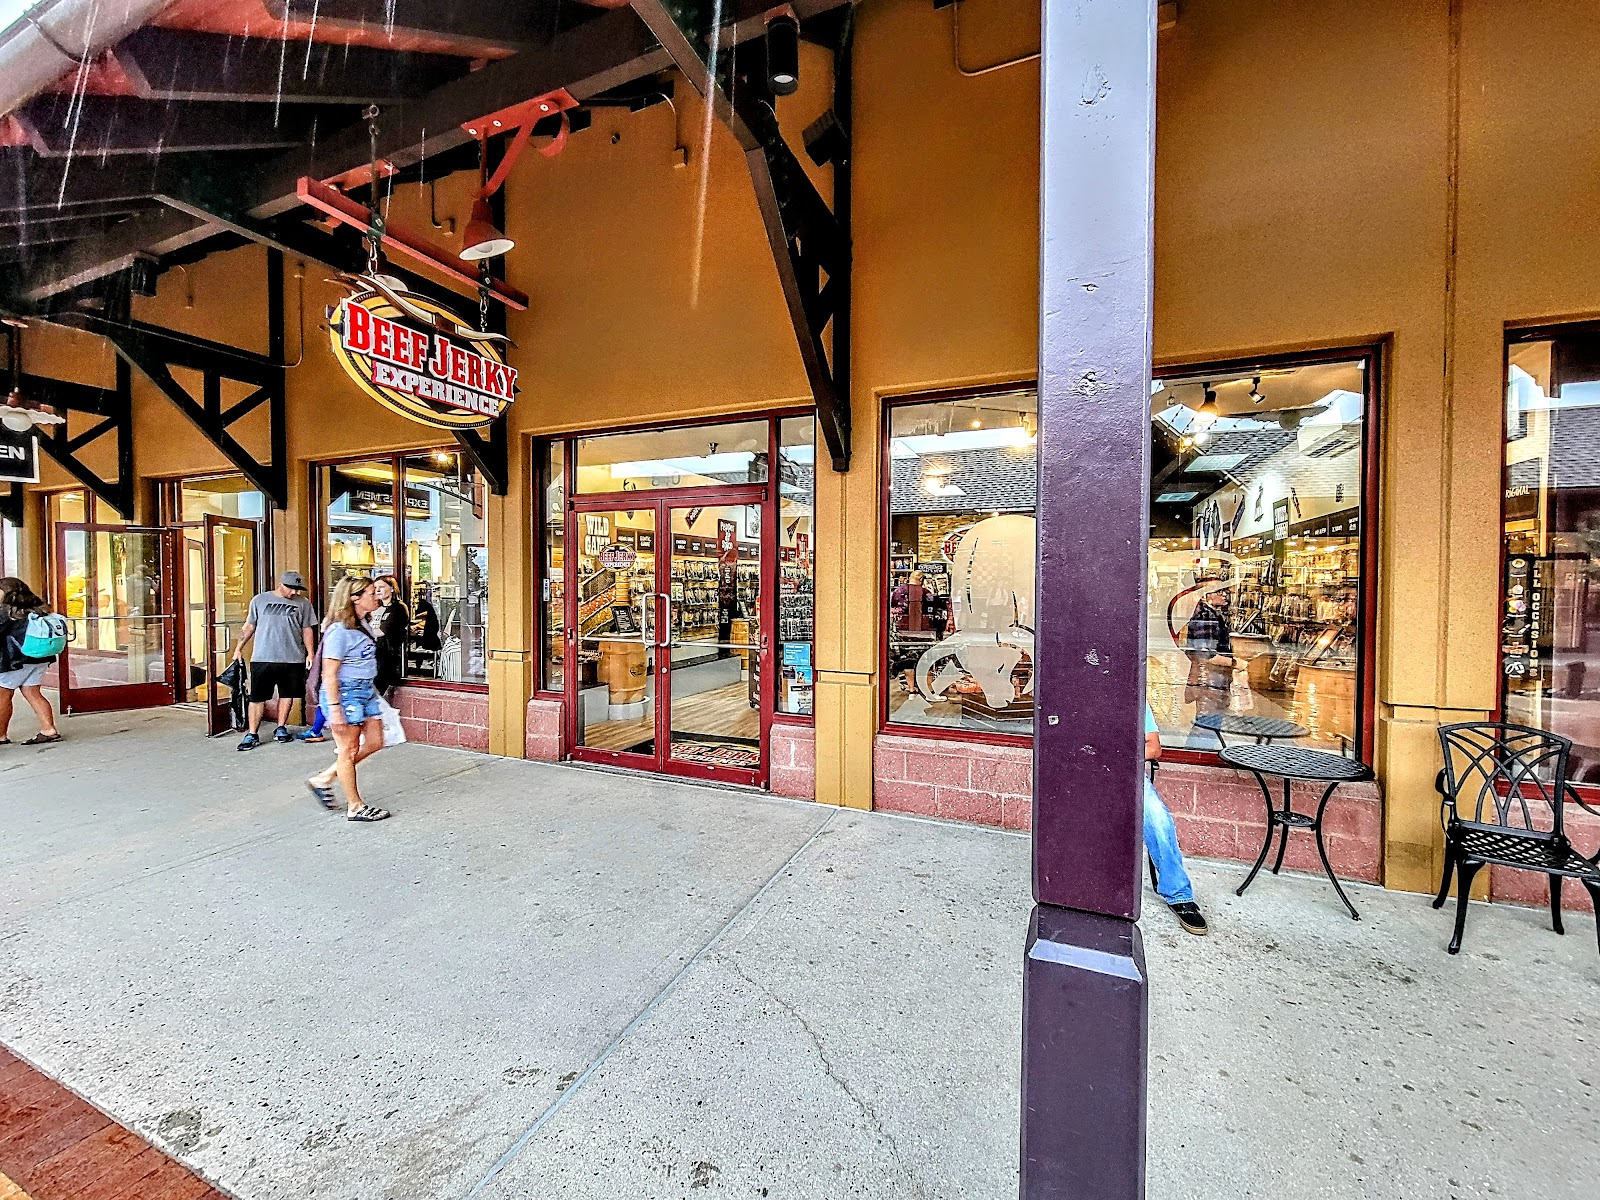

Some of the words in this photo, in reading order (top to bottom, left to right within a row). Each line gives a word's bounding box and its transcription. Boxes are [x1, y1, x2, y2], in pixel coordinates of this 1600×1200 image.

[346, 301, 428, 371] BEEF
[431, 336, 518, 400] JERKY
[375, 361, 500, 415] EXPERIENCE
[586, 514, 609, 536] WILD
[599, 551, 615, 561] BEEF
[615, 550, 636, 561] JERKY
[263, 603, 300, 616] NIKE
[1529, 592, 1541, 677] OCCASIONS
